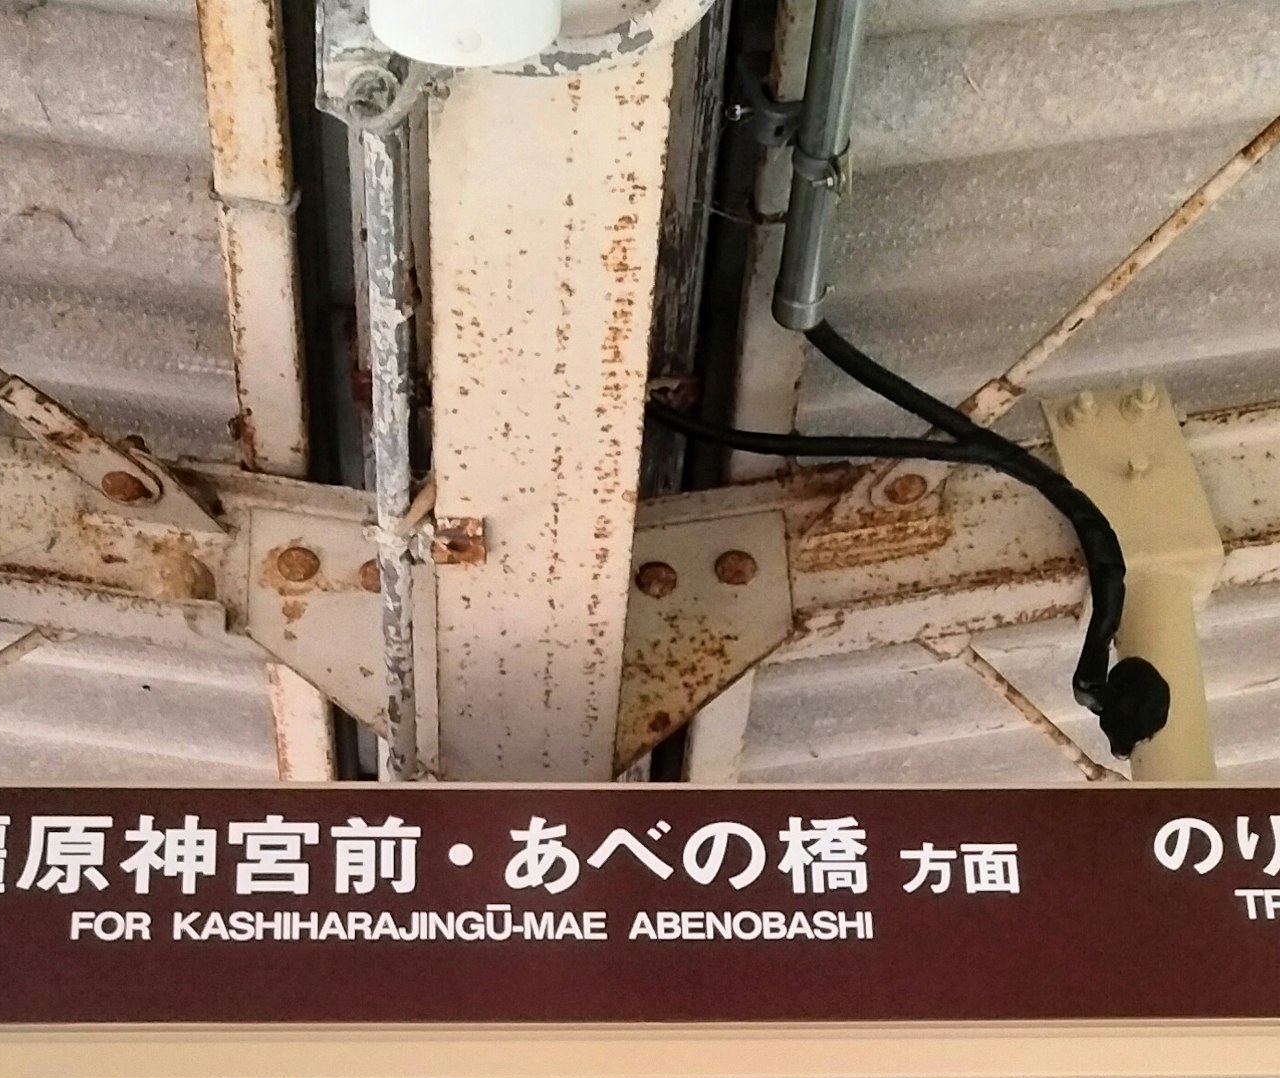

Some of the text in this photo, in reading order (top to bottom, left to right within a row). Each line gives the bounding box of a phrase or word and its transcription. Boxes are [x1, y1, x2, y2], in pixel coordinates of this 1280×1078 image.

[899, 841, 1021, 895] 方面
[69, 903, 874, 941] FOR KASHIHARAJINGŪ-MAE ABENOBASHI
